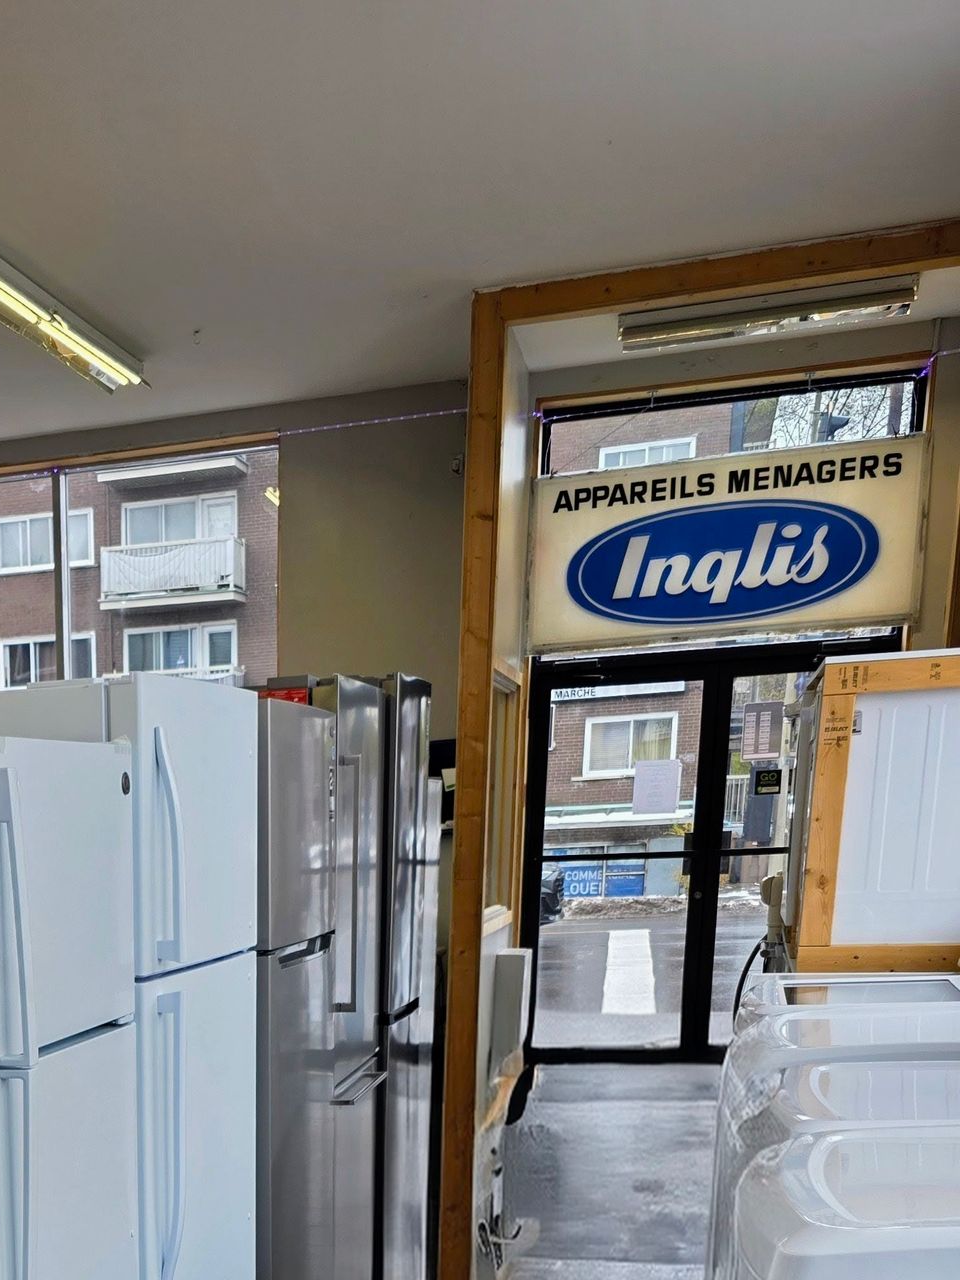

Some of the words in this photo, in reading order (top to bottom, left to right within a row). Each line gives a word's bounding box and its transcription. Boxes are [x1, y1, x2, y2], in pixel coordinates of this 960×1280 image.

[552, 472, 716, 513] APPAREILS
[727, 452, 903, 494] MENAGERS
[612, 522, 830, 605] Inglis
[553, 688, 596, 699] MARCHE
[760, 772, 778, 781] GO
